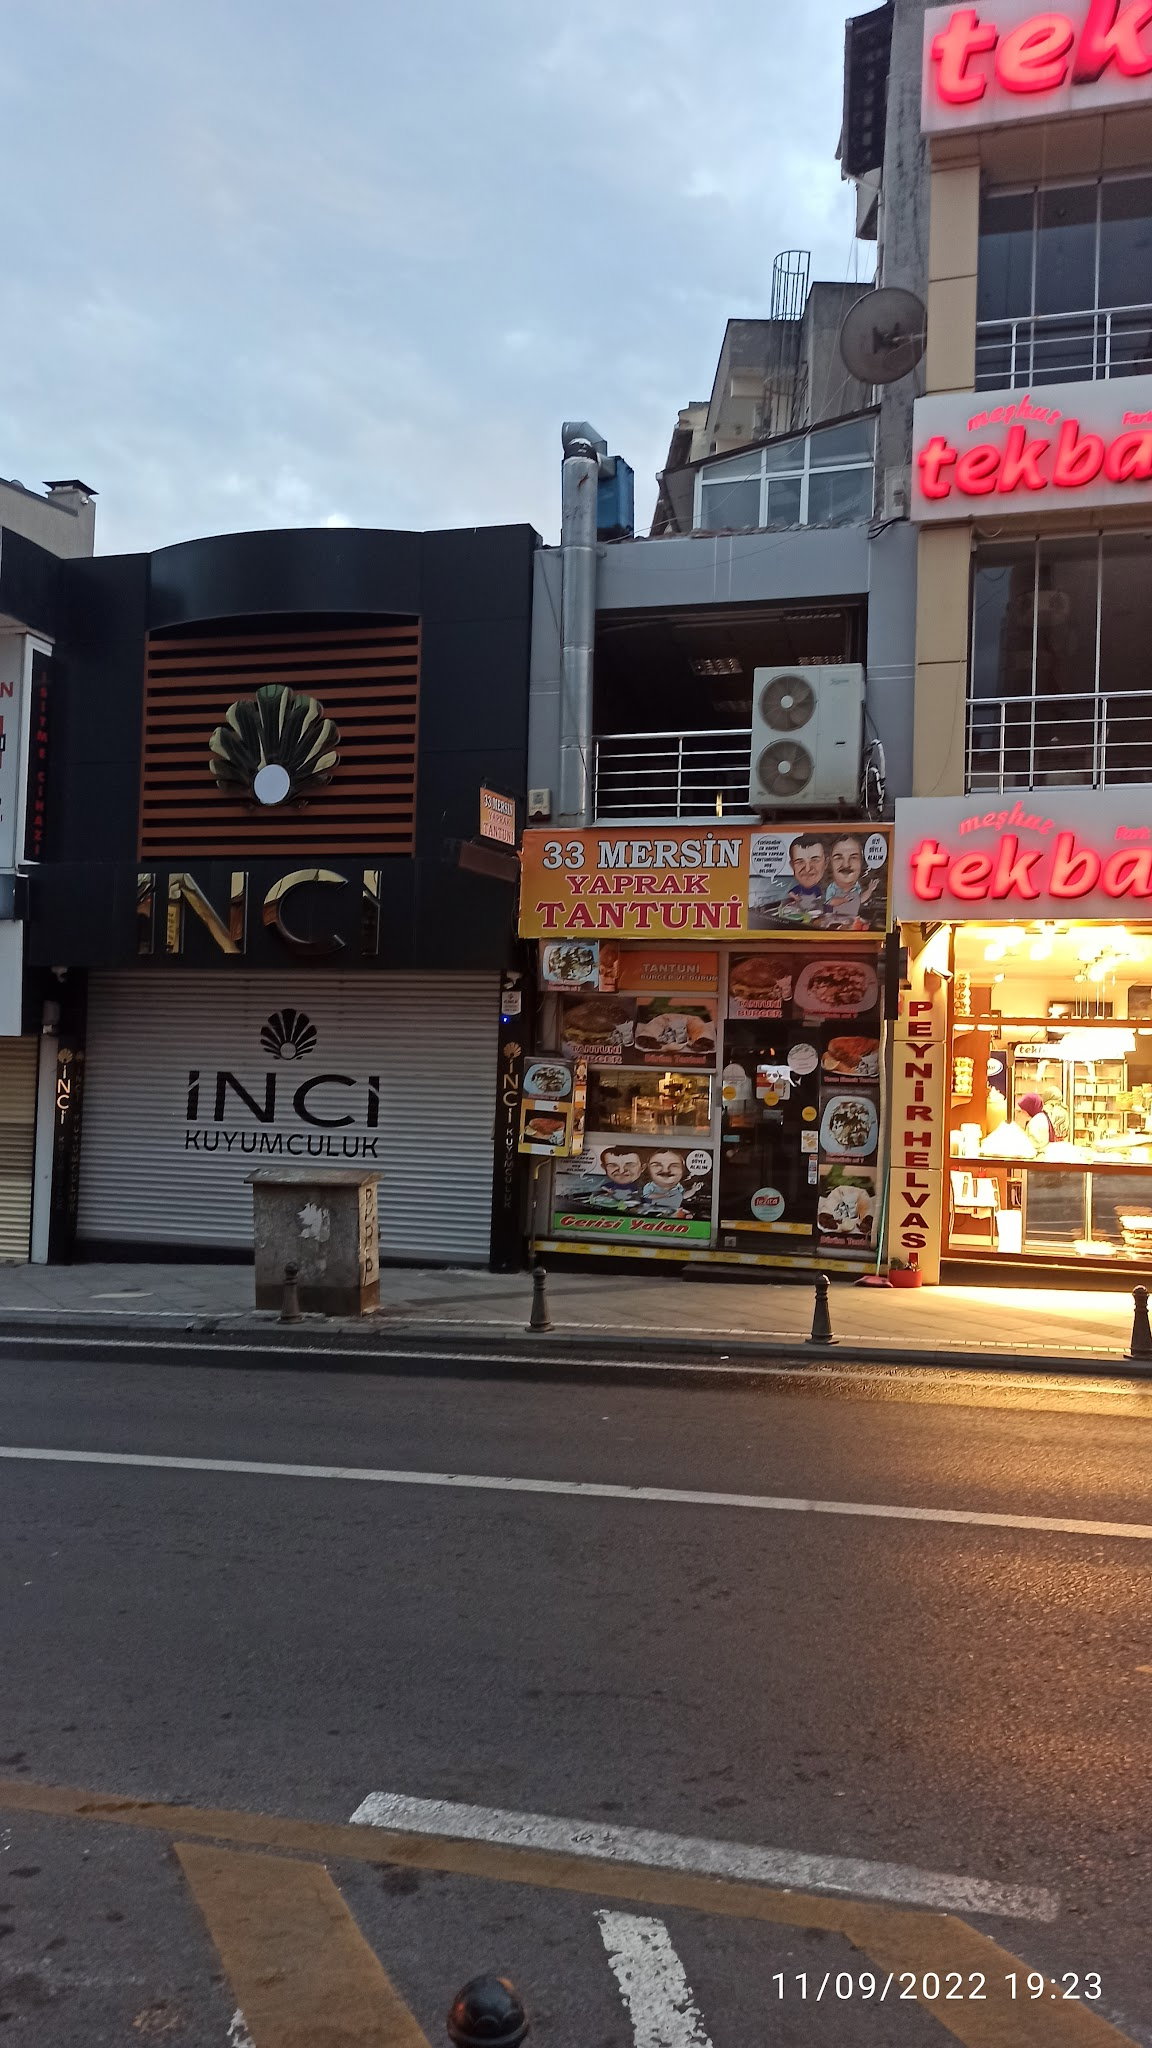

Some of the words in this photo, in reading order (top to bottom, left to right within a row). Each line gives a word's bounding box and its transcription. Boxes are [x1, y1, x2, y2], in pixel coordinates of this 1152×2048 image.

[543, 840, 585, 869] 33
[597, 832, 743, 869] MERSİN
[566, 873, 711, 896] YAPRAK
[534, 894, 743, 930] TANTUNİ
[904, 1001, 934, 1122] PEYNİR
[185, 1129, 379, 1158] KUYUMCULUK
[560, 1215, 625, 1229] Gerisi
[630, 1217, 690, 1234] Yalan
